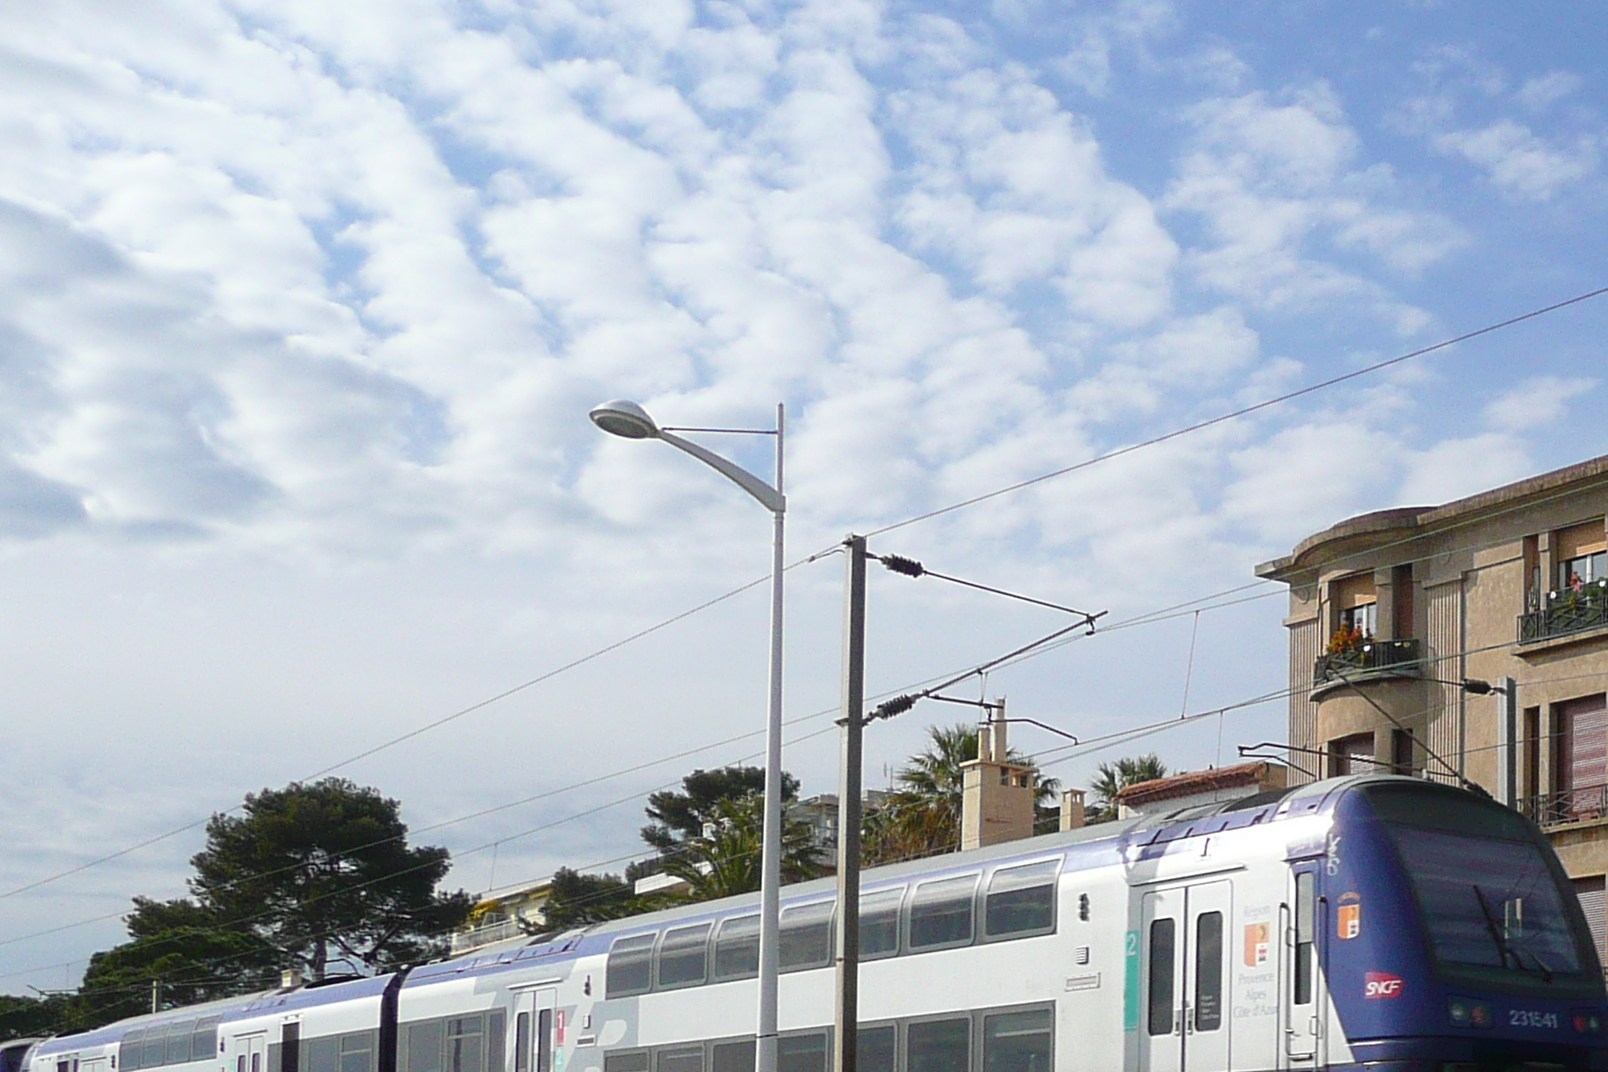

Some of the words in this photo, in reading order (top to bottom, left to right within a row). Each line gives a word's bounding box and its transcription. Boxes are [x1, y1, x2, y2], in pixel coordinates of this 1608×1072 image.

[1127, 933, 1137, 956] 2
[1238, 972, 1275, 985] Provence
[1365, 980, 1402, 996] SNCF
[557, 1012, 563, 1030] 1
